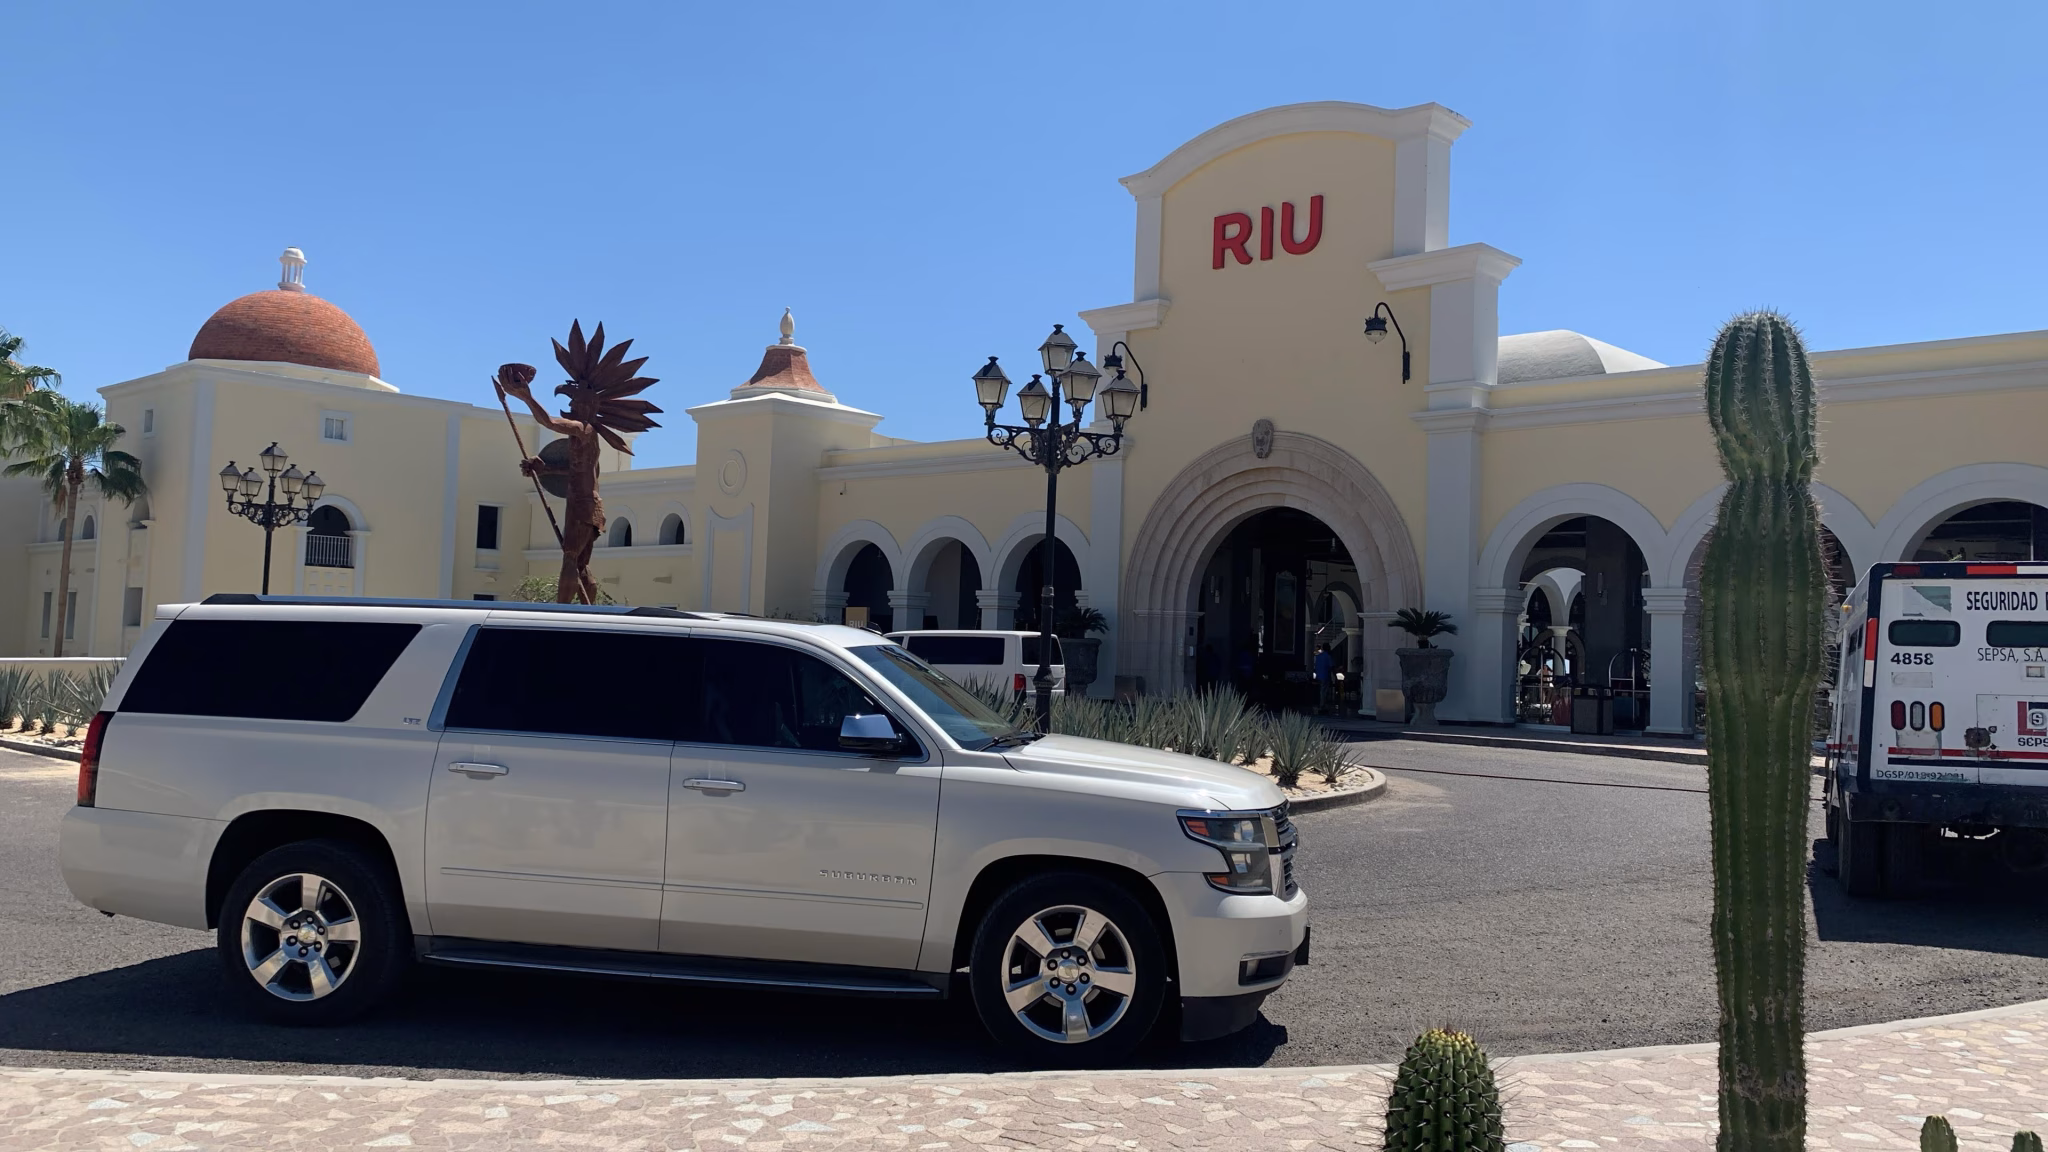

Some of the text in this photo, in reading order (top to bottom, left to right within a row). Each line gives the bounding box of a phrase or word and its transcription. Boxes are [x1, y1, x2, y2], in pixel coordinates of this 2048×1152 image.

[1212, 195, 1324, 270] RIU
[1966, 591, 2038, 611] SEGURIDAD
[1890, 652, 1934, 666] 4858
[1977, 647, 2047, 663] SEPSA, S.A.
[819, 869, 917, 886] SUBURBAN
